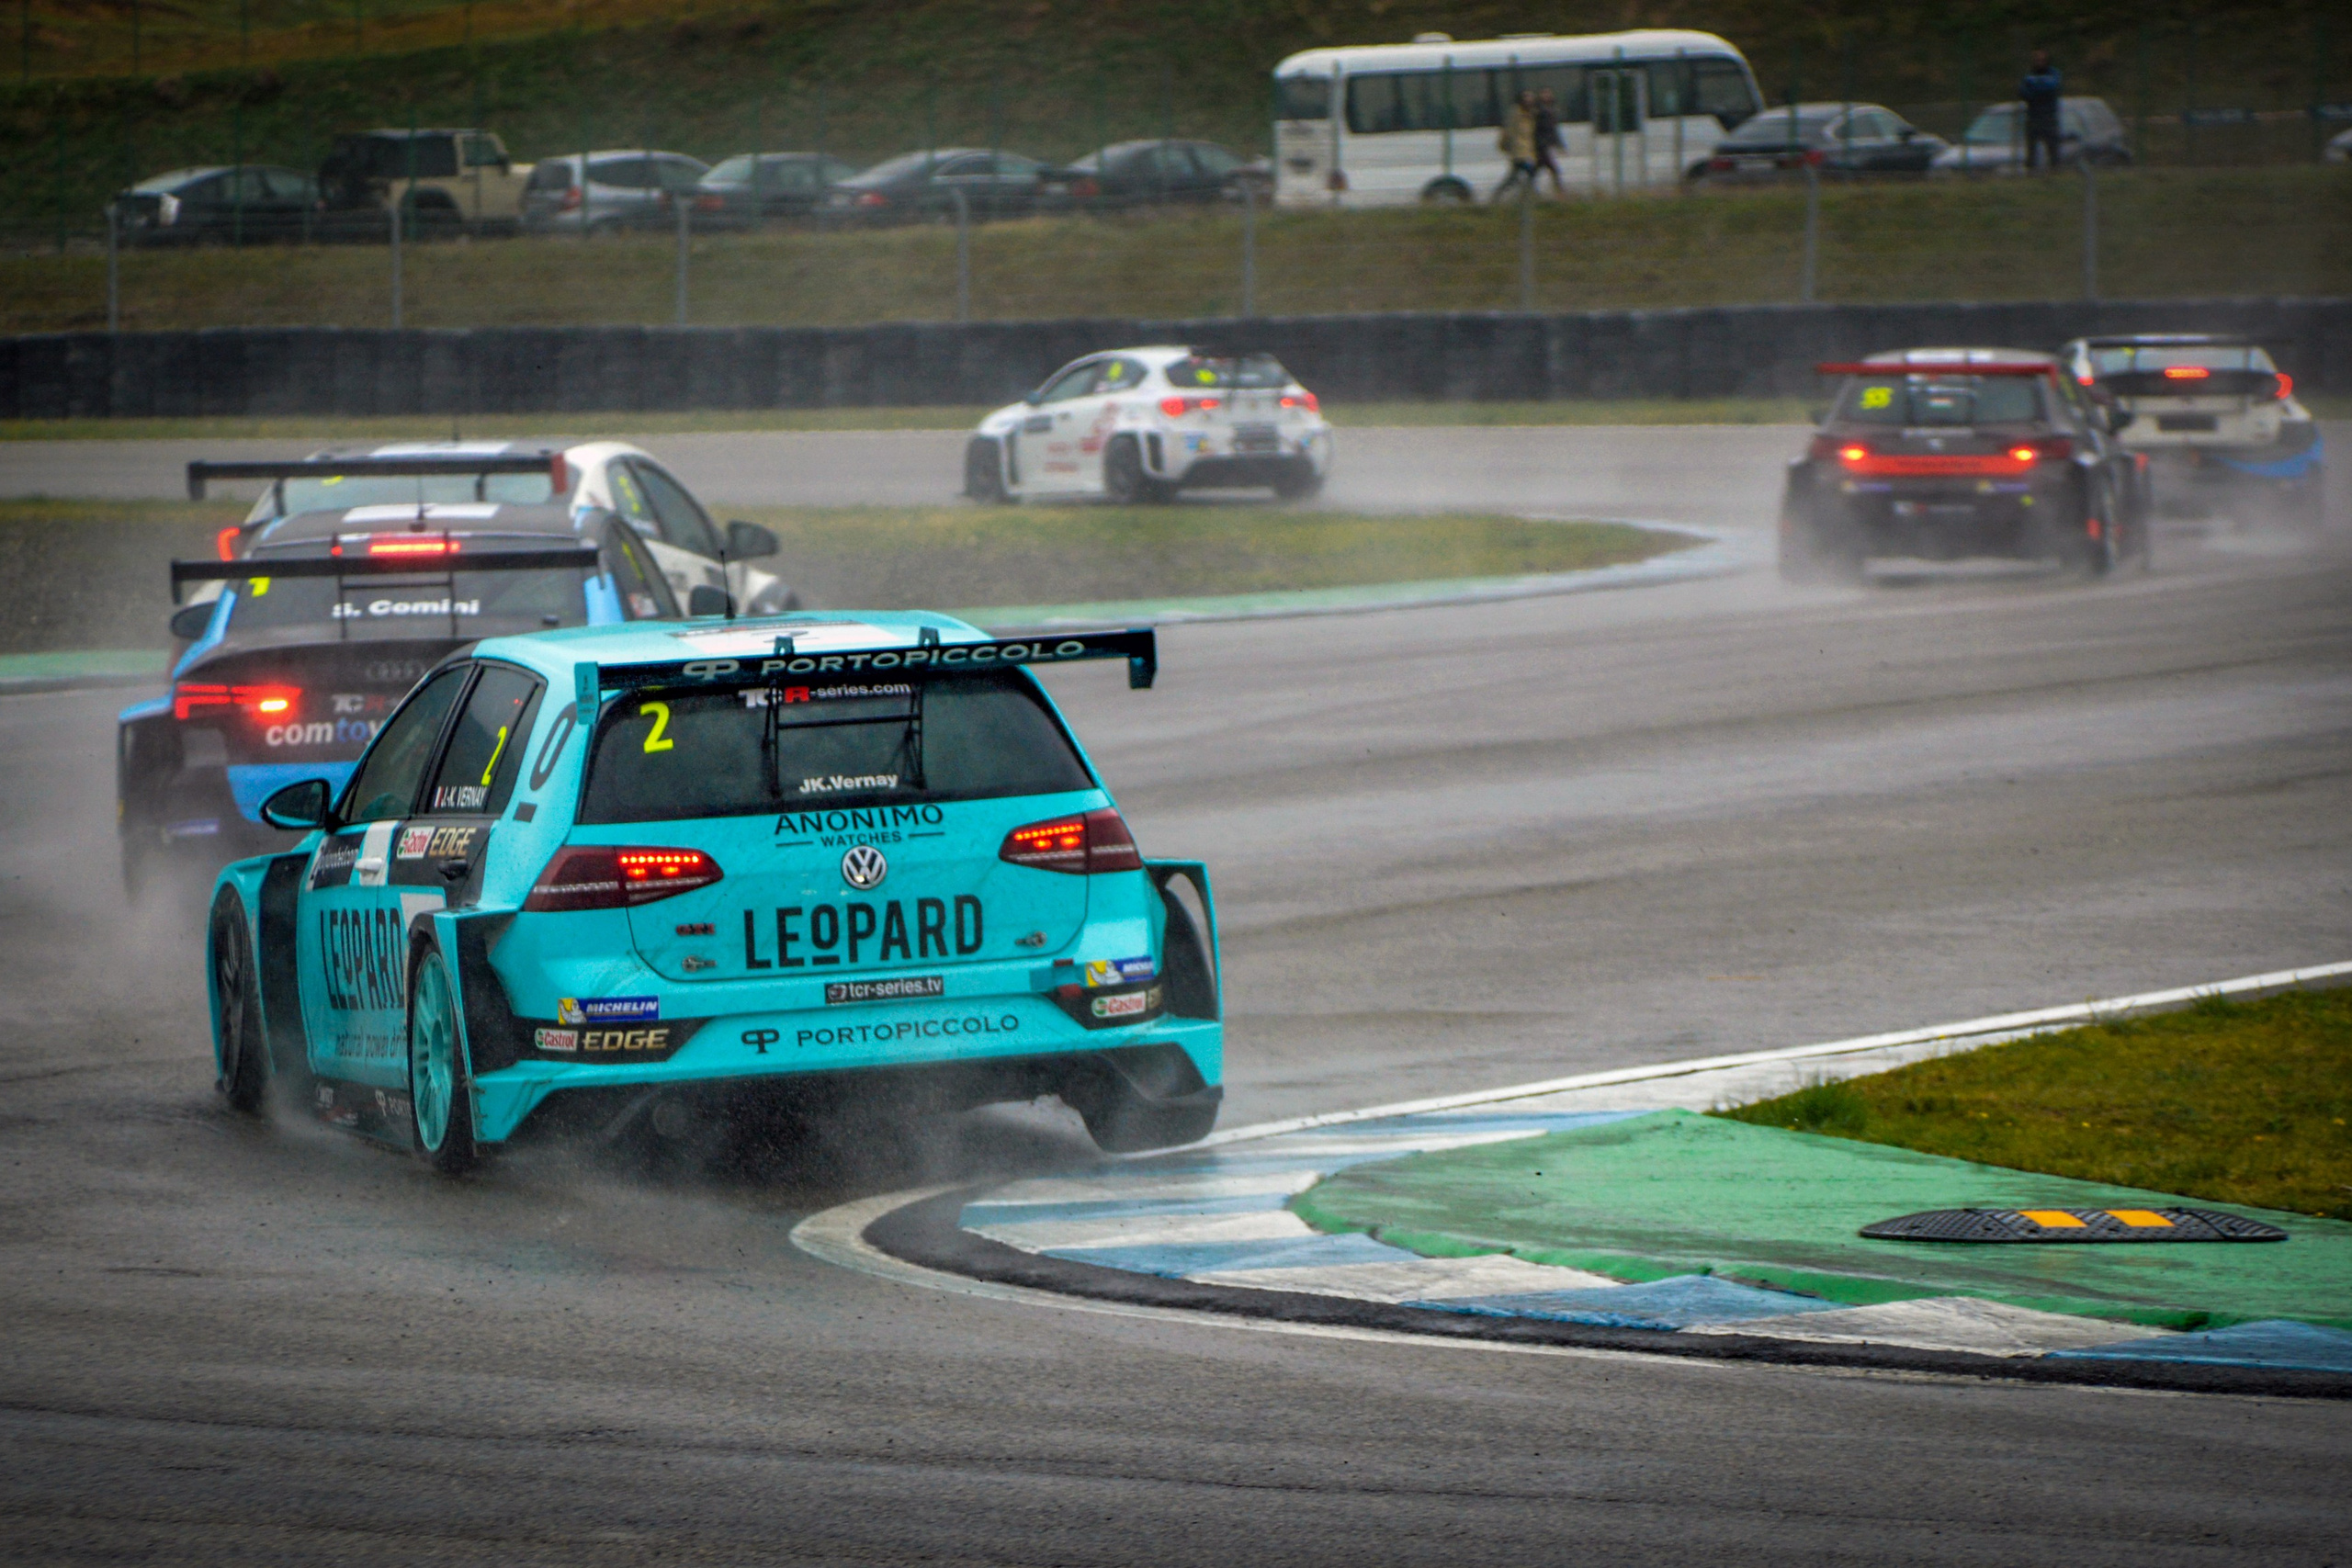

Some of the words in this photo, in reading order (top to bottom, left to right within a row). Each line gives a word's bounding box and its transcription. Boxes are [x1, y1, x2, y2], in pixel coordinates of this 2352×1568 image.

[368, 599, 480, 616] Comini
[760, 641, 1085, 676] PORTOPICCOLO
[639, 701, 674, 754] 2
[481, 725, 507, 786] 2
[798, 773, 899, 795] JK.Vernay
[775, 804, 944, 836] ANONIMO
[428, 827, 477, 856] EDGE
[820, 831, 902, 848] WATCHES
[744, 894, 983, 970] LEOPARD
[320, 907, 405, 1010] LEOPARD
[848, 976, 943, 999] tcr-series.tv
[585, 1000, 659, 1014] MICHELIN
[544, 1032, 576, 1049] Castrol
[582, 1028, 670, 1052] EDGE
[797, 1015, 1020, 1047] PORTOPICCOLO
